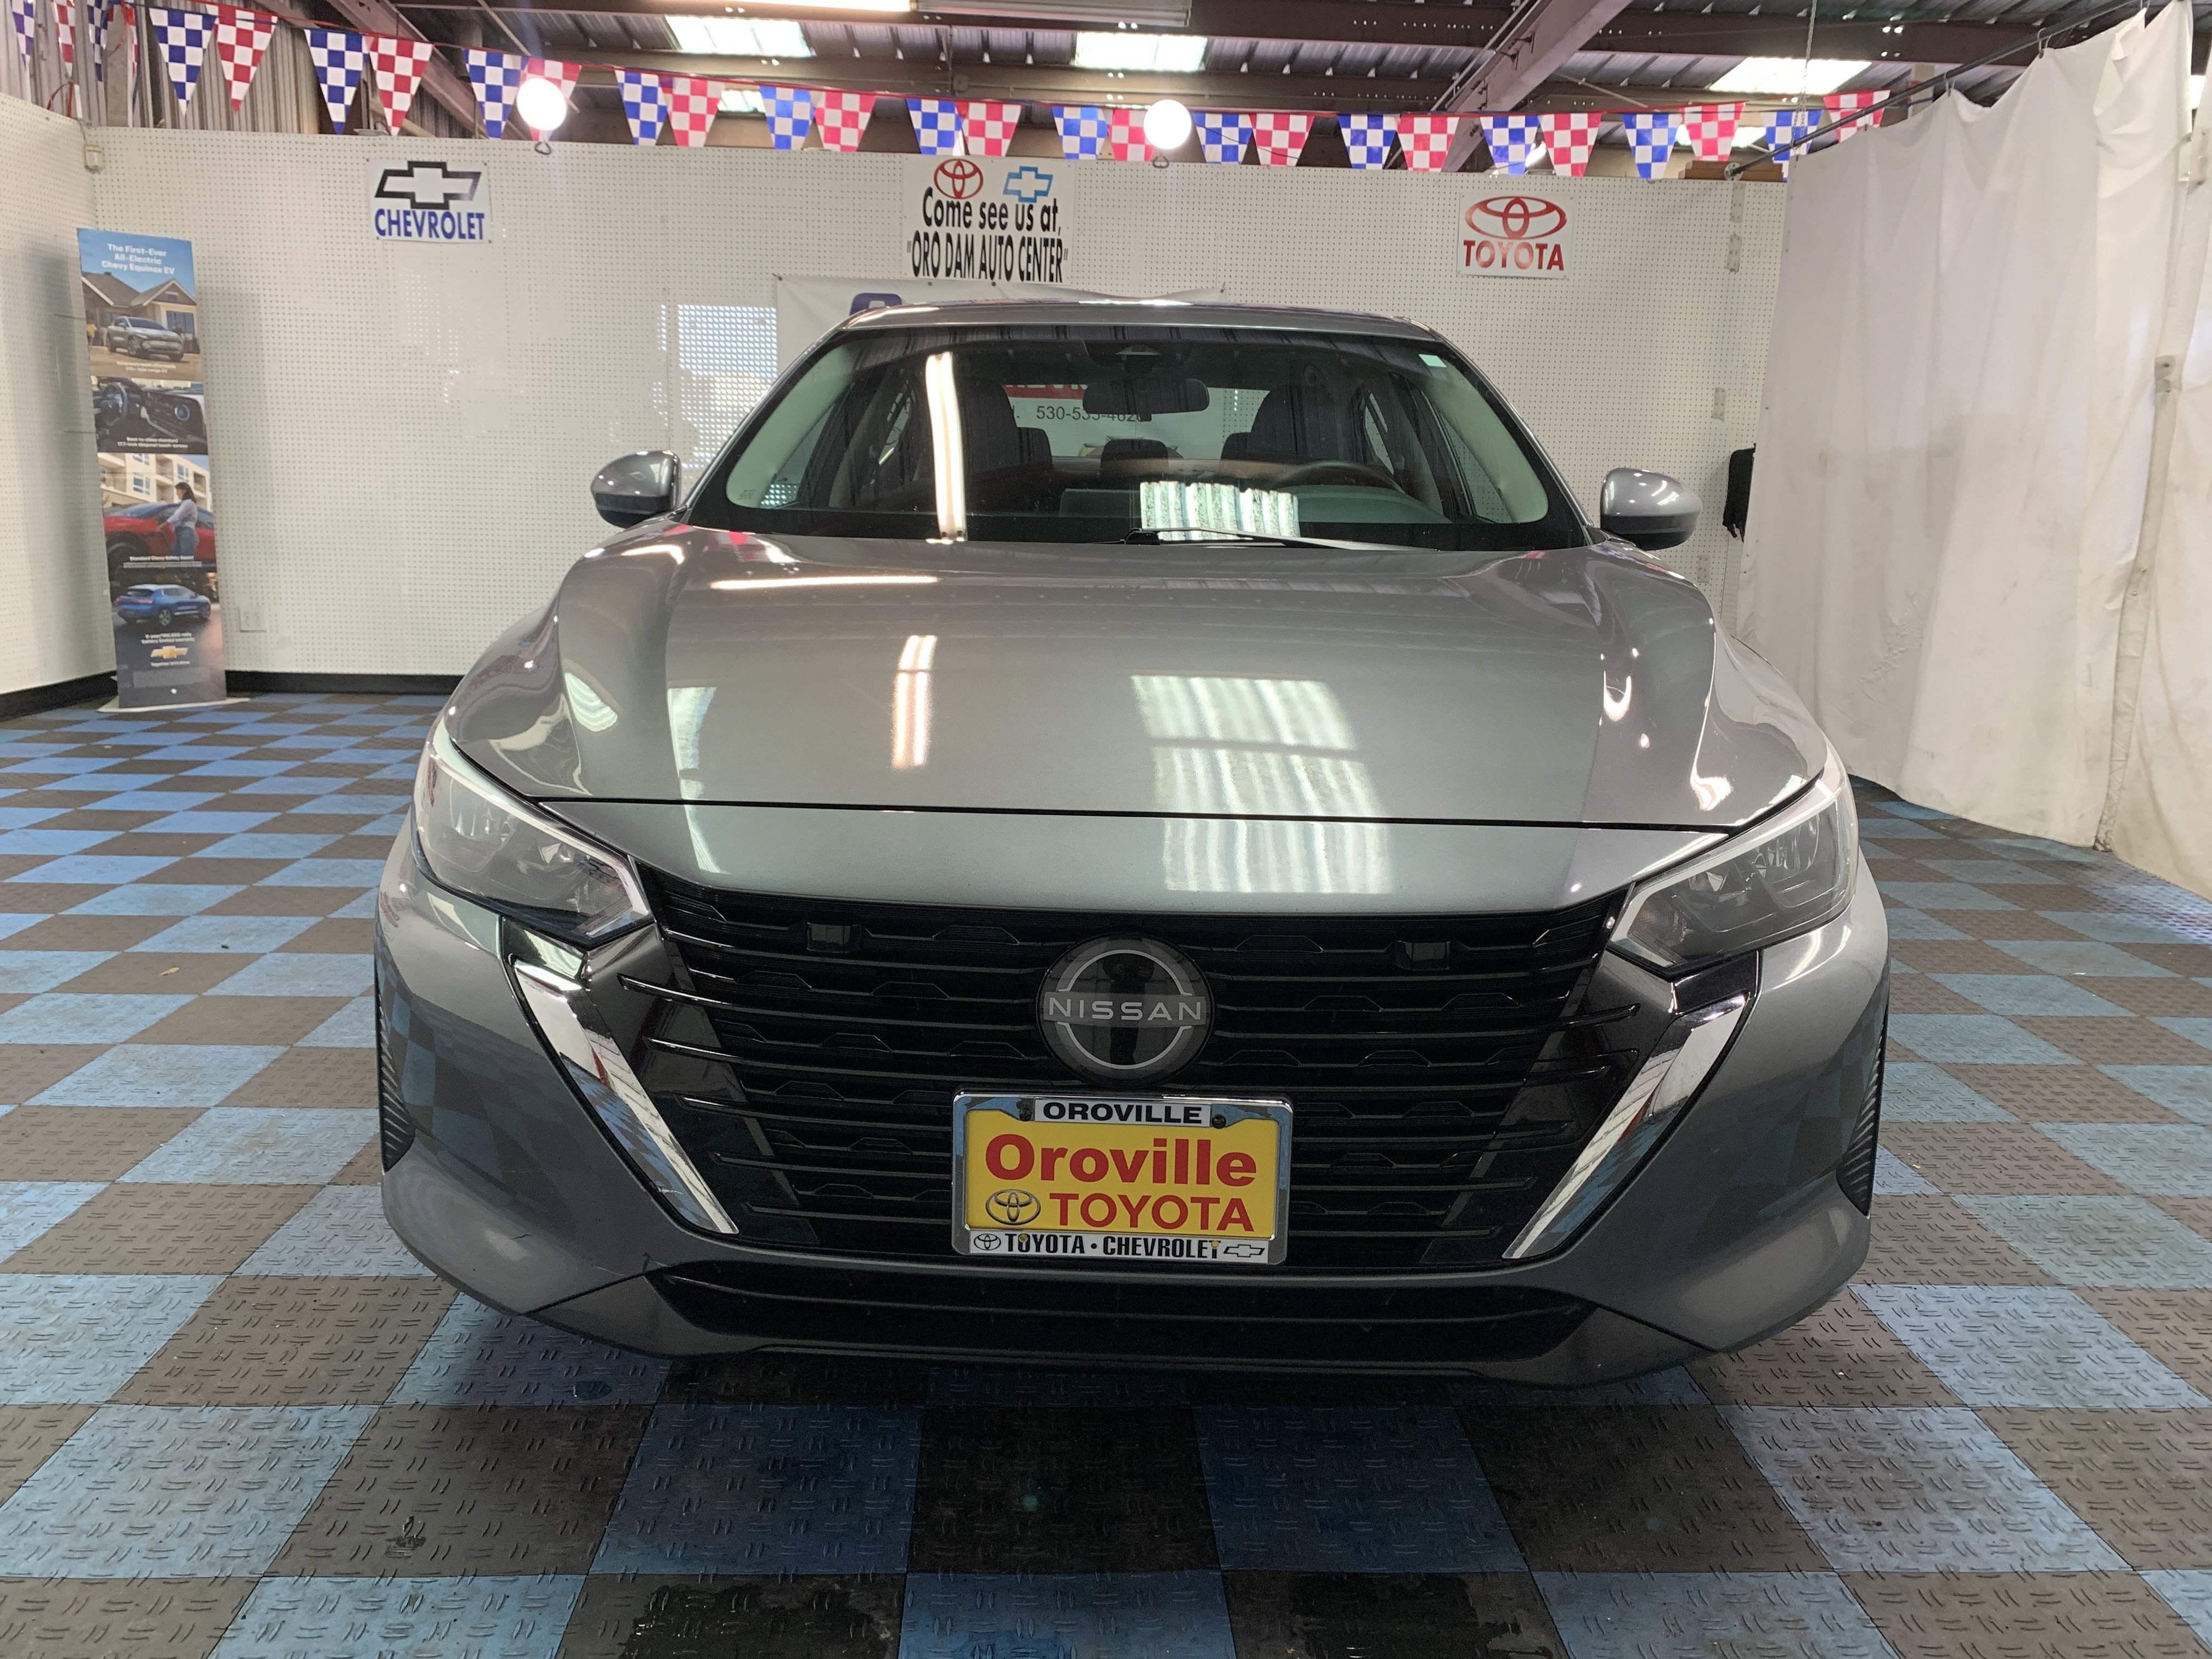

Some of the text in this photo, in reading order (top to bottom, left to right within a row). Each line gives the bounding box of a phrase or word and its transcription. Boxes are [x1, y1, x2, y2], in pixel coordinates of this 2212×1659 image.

[375, 208, 484, 240] CHEVROLET
[923, 186, 1061, 236] Come see us at,
[107, 243, 123, 252] The
[979, 234, 1014, 281] AUTO
[1463, 240, 1564, 270] TOYOTA
[101, 260, 174, 275] Chevy Equinox EV
[1048, 997, 1201, 1021] NISSAN
[1043, 1102, 1202, 1124] OROVILLE
[985, 1133, 1257, 1187] Oroville
[1049, 1193, 1255, 1232] TOYOTA
[1005, 1233, 1221, 1259] TOYOTA CHEVROLET
